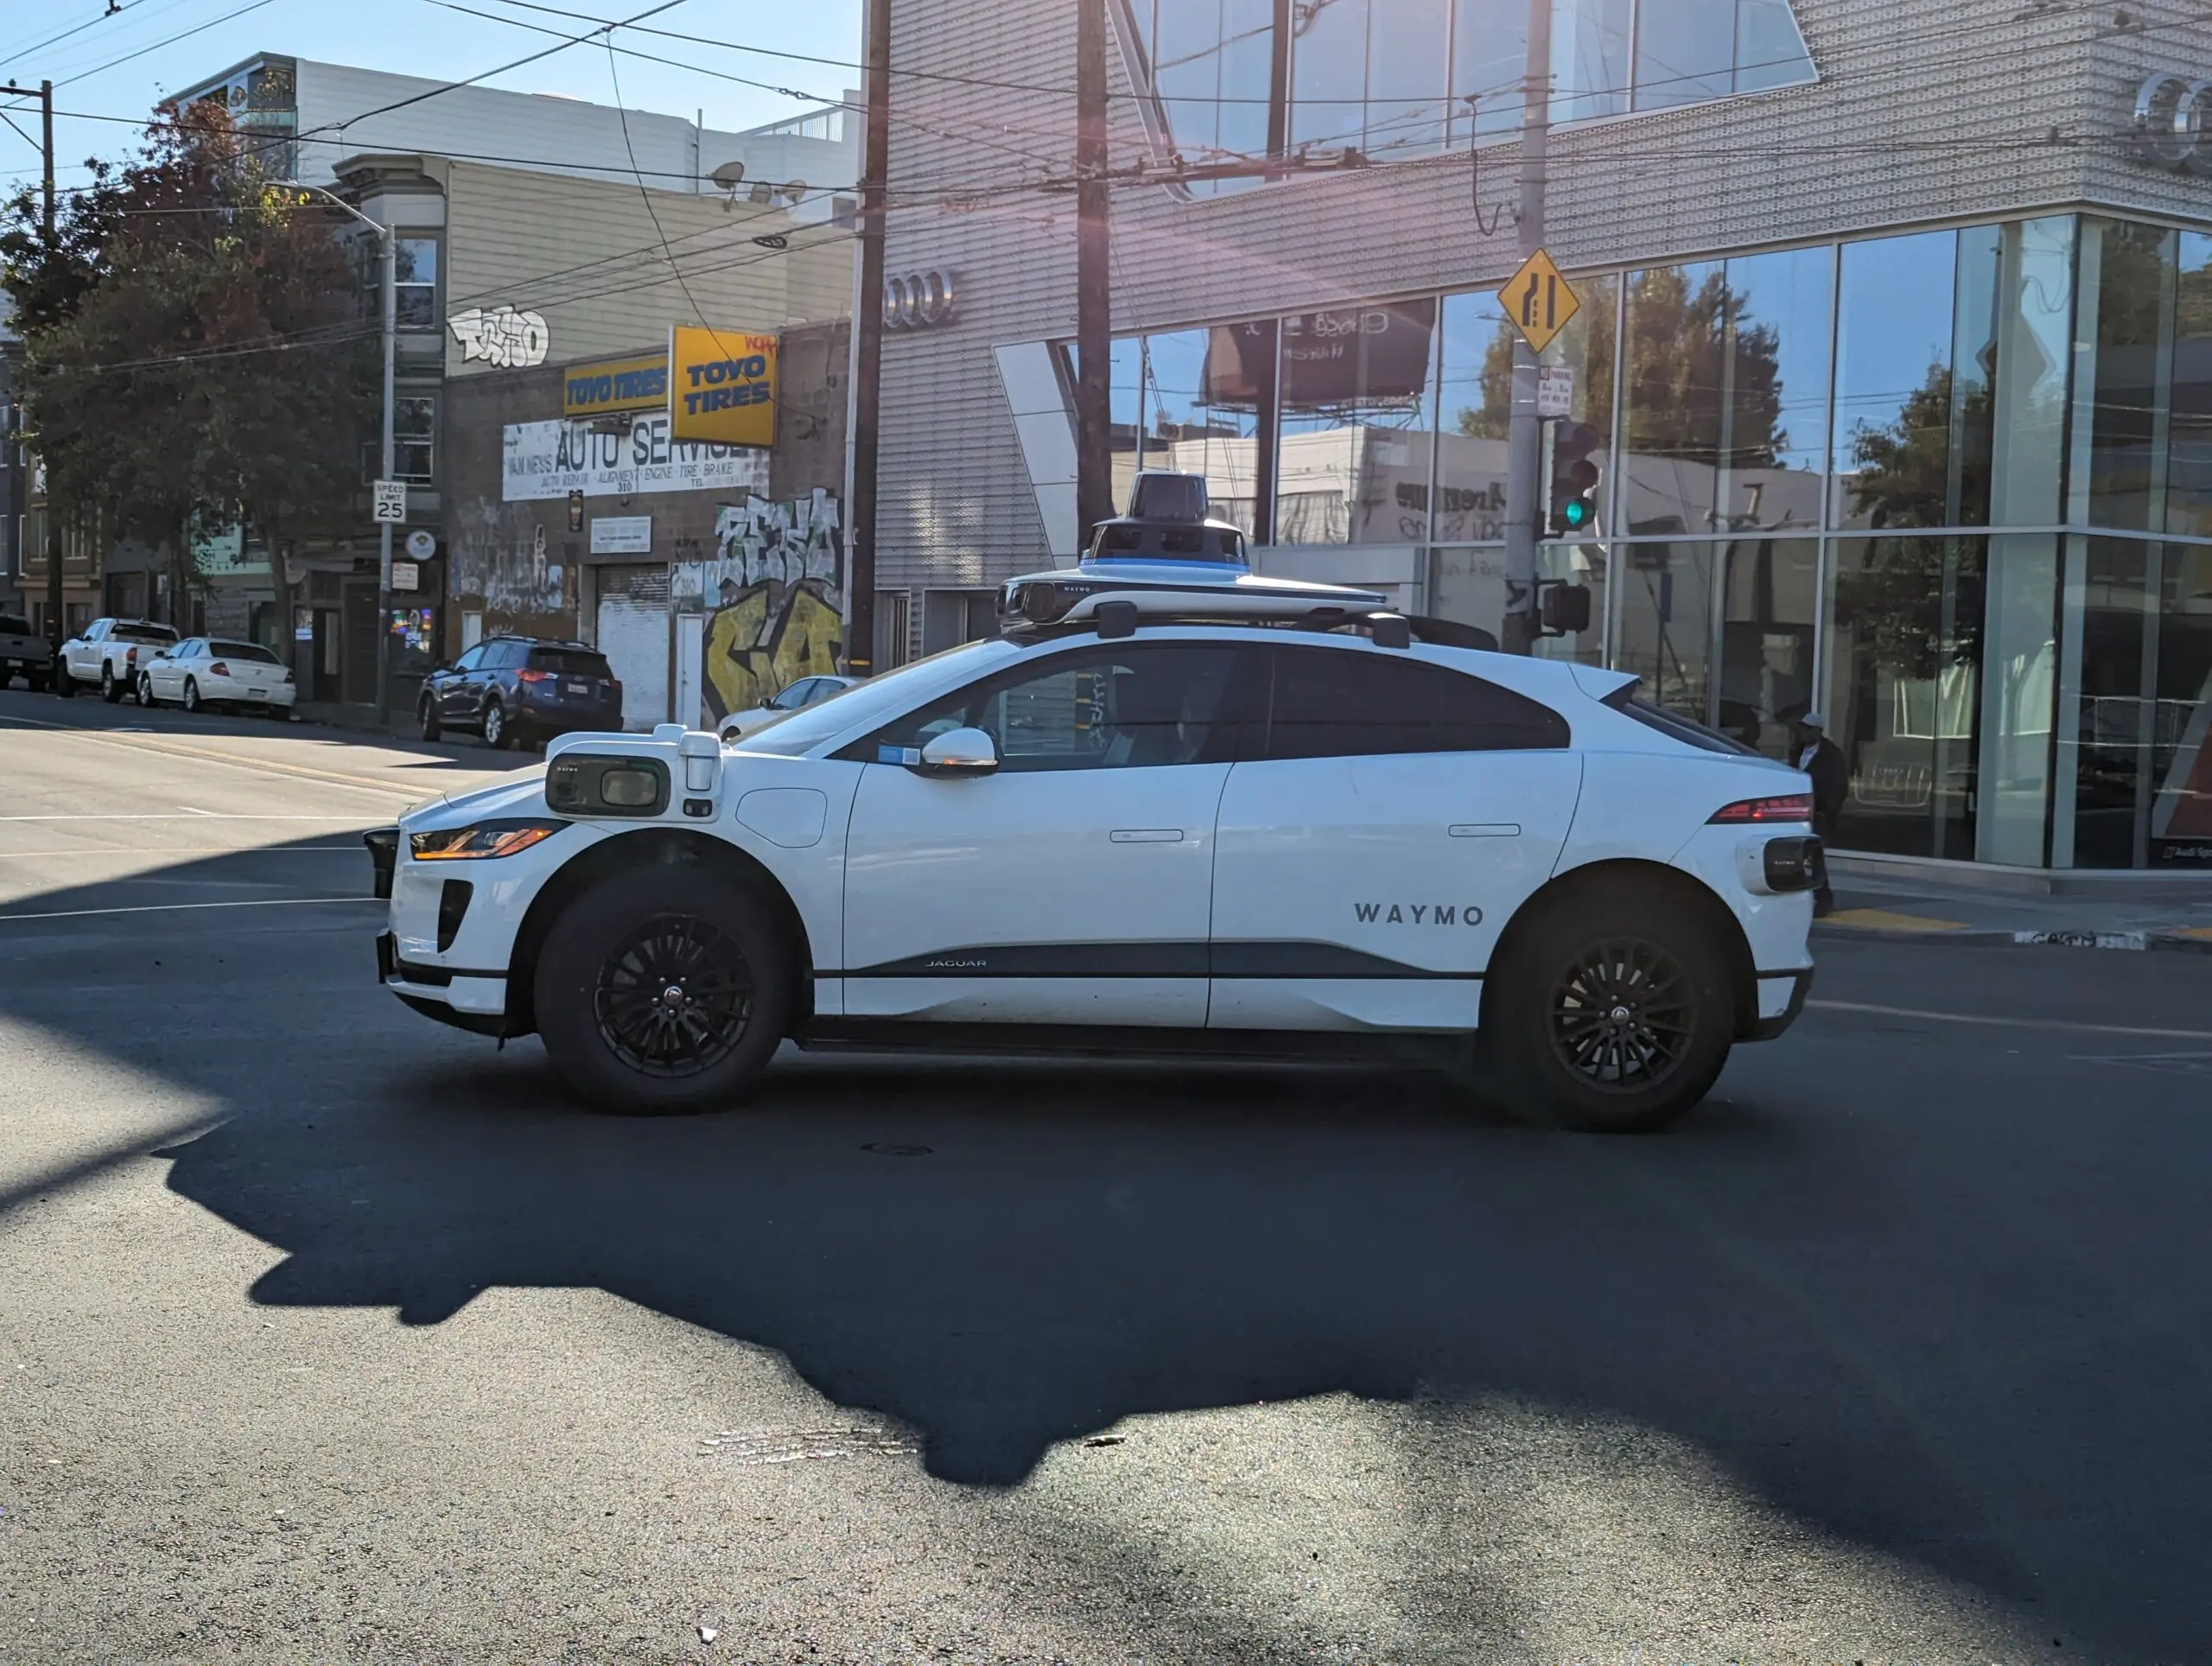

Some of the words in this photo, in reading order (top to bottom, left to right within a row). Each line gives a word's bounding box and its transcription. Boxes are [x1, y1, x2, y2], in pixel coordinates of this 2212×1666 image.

[687, 355, 766, 386] TOYO
[566, 375, 613, 405] TOYO
[613, 366, 668, 400] TIRES
[684, 381, 770, 415] TIRES
[555, 423, 620, 474] AUTO
[645, 467, 673, 480] ENGINE
[680, 464, 698, 478] TIRE
[703, 461, 734, 476] BRAKE
[617, 482, 632, 493] 310
[378, 502, 403, 518] 25
[1354, 903, 1483, 925] WAYMO
